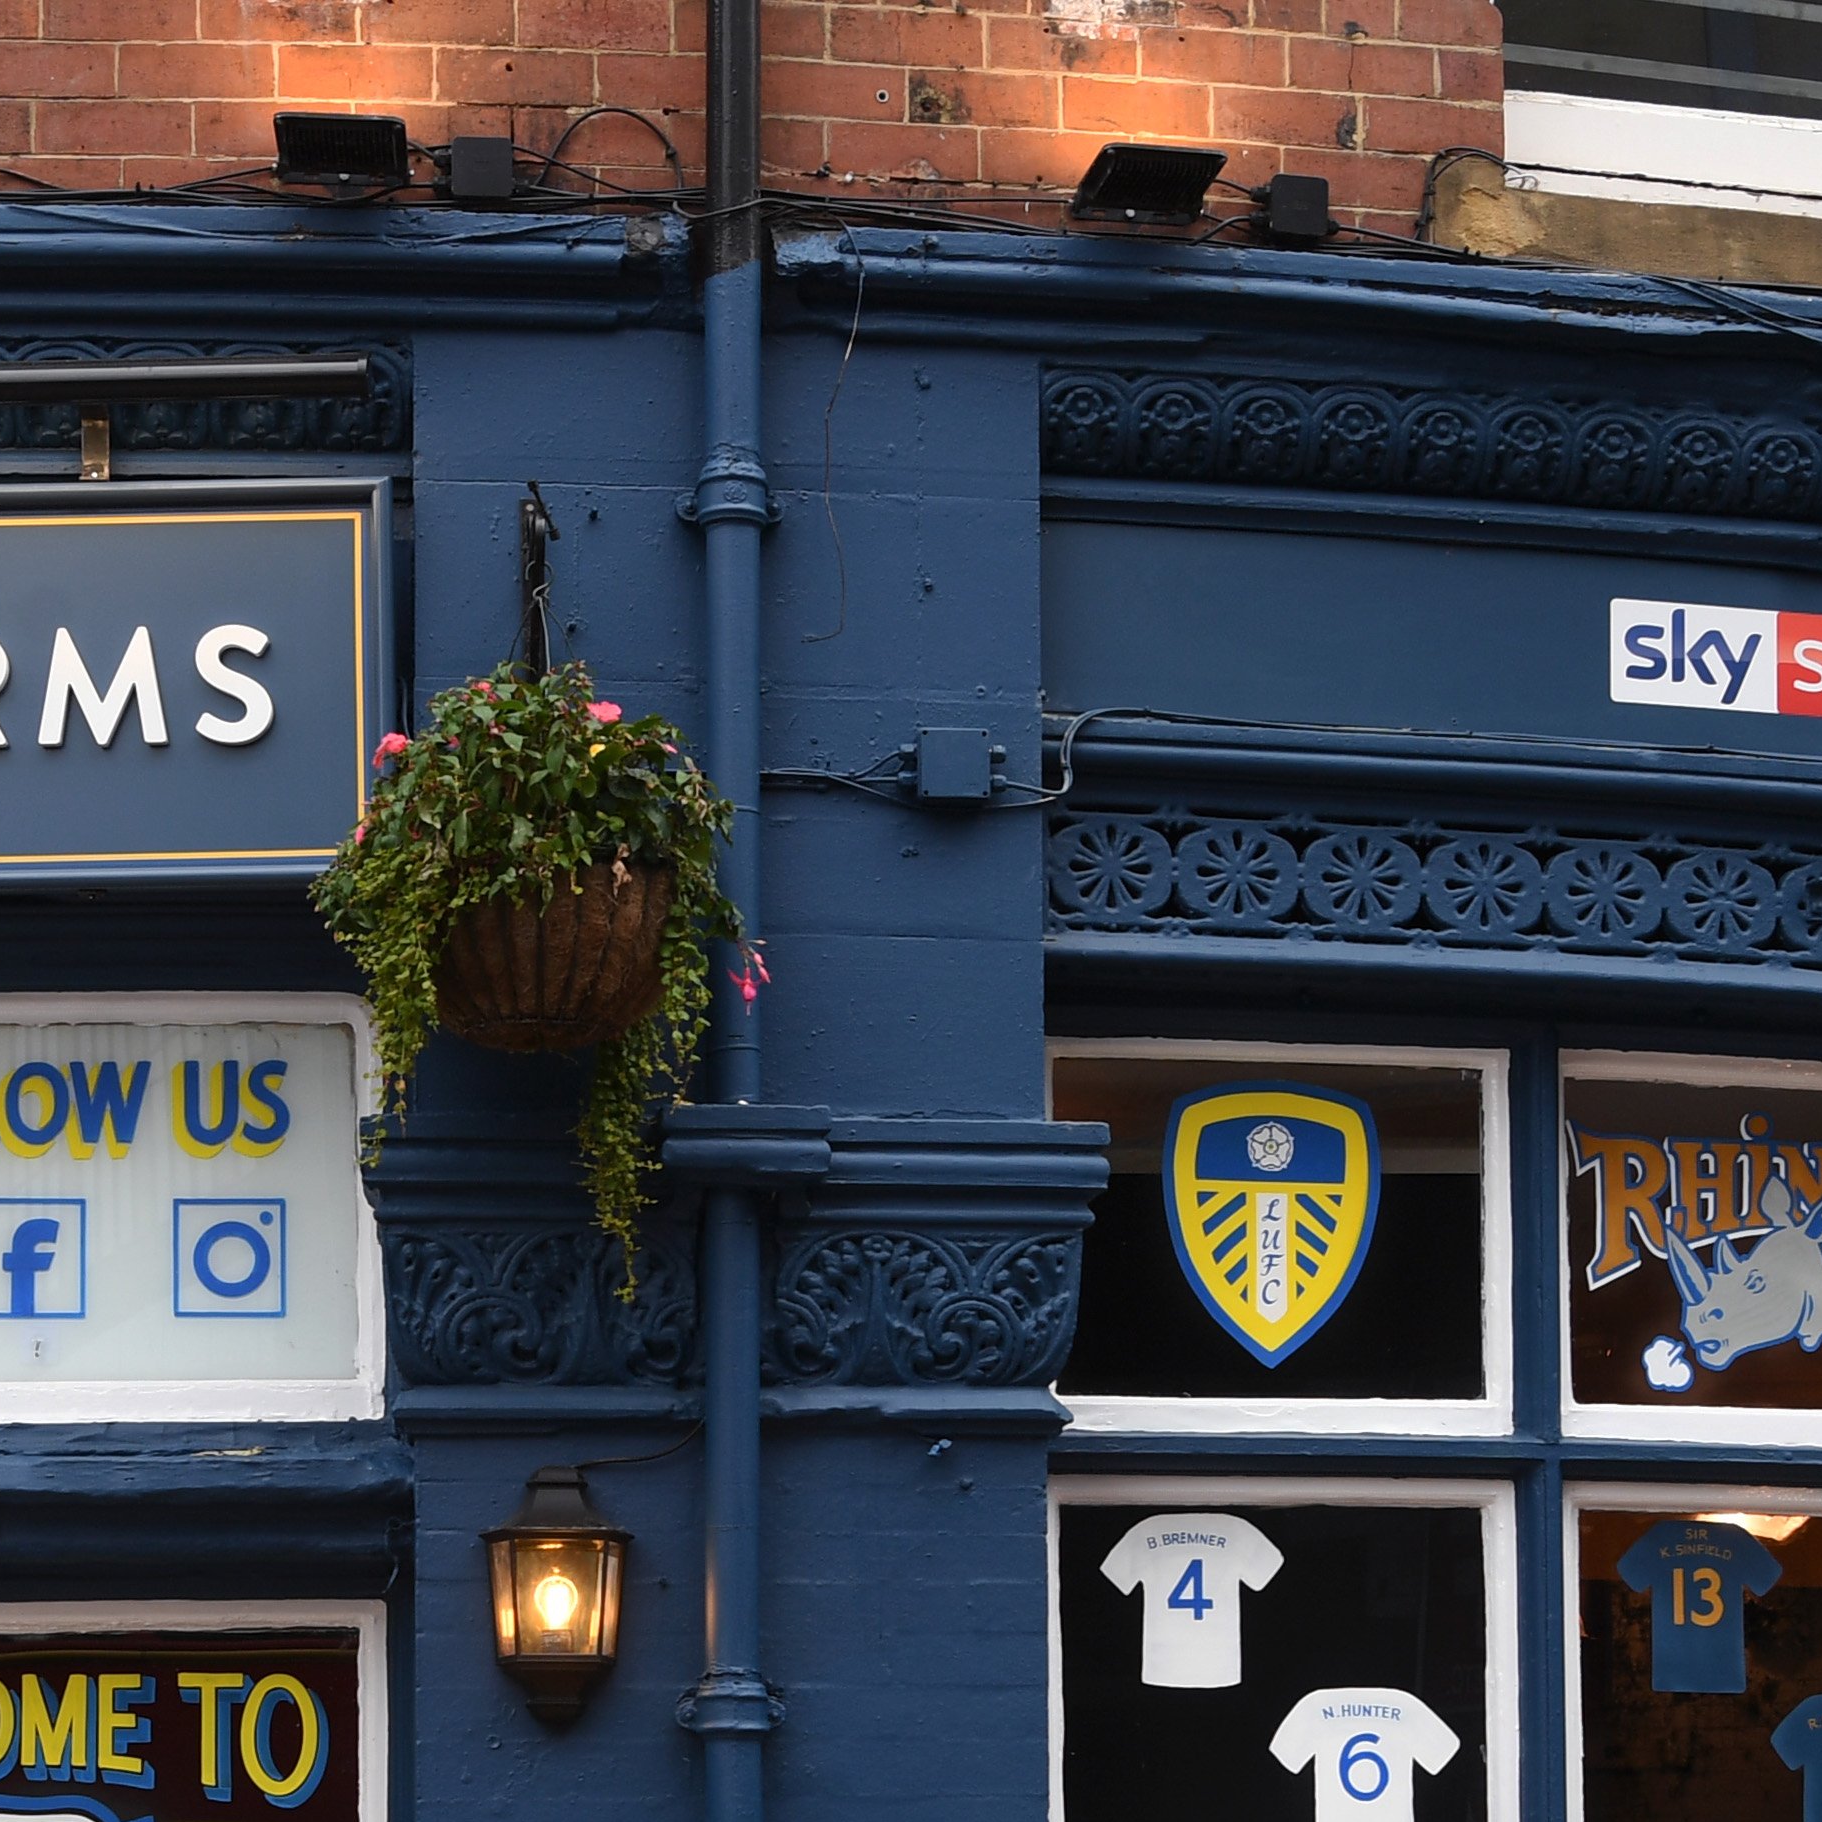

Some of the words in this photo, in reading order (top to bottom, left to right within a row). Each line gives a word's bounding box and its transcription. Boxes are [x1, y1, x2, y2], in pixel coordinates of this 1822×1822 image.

[1624, 608, 1762, 705] sky
[172, 1059, 290, 1159] US
[1146, 1532, 1227, 1549] B.BREMNER
[1685, 1528, 1708, 1540] SIR
[1166, 1558, 1213, 1621] 4
[1672, 1568, 1725, 1627] 13
[178, 1673, 329, 1807] TO
[1322, 1704, 1401, 1721] N.HUNTER
[1338, 1732, 1389, 1802] 6
